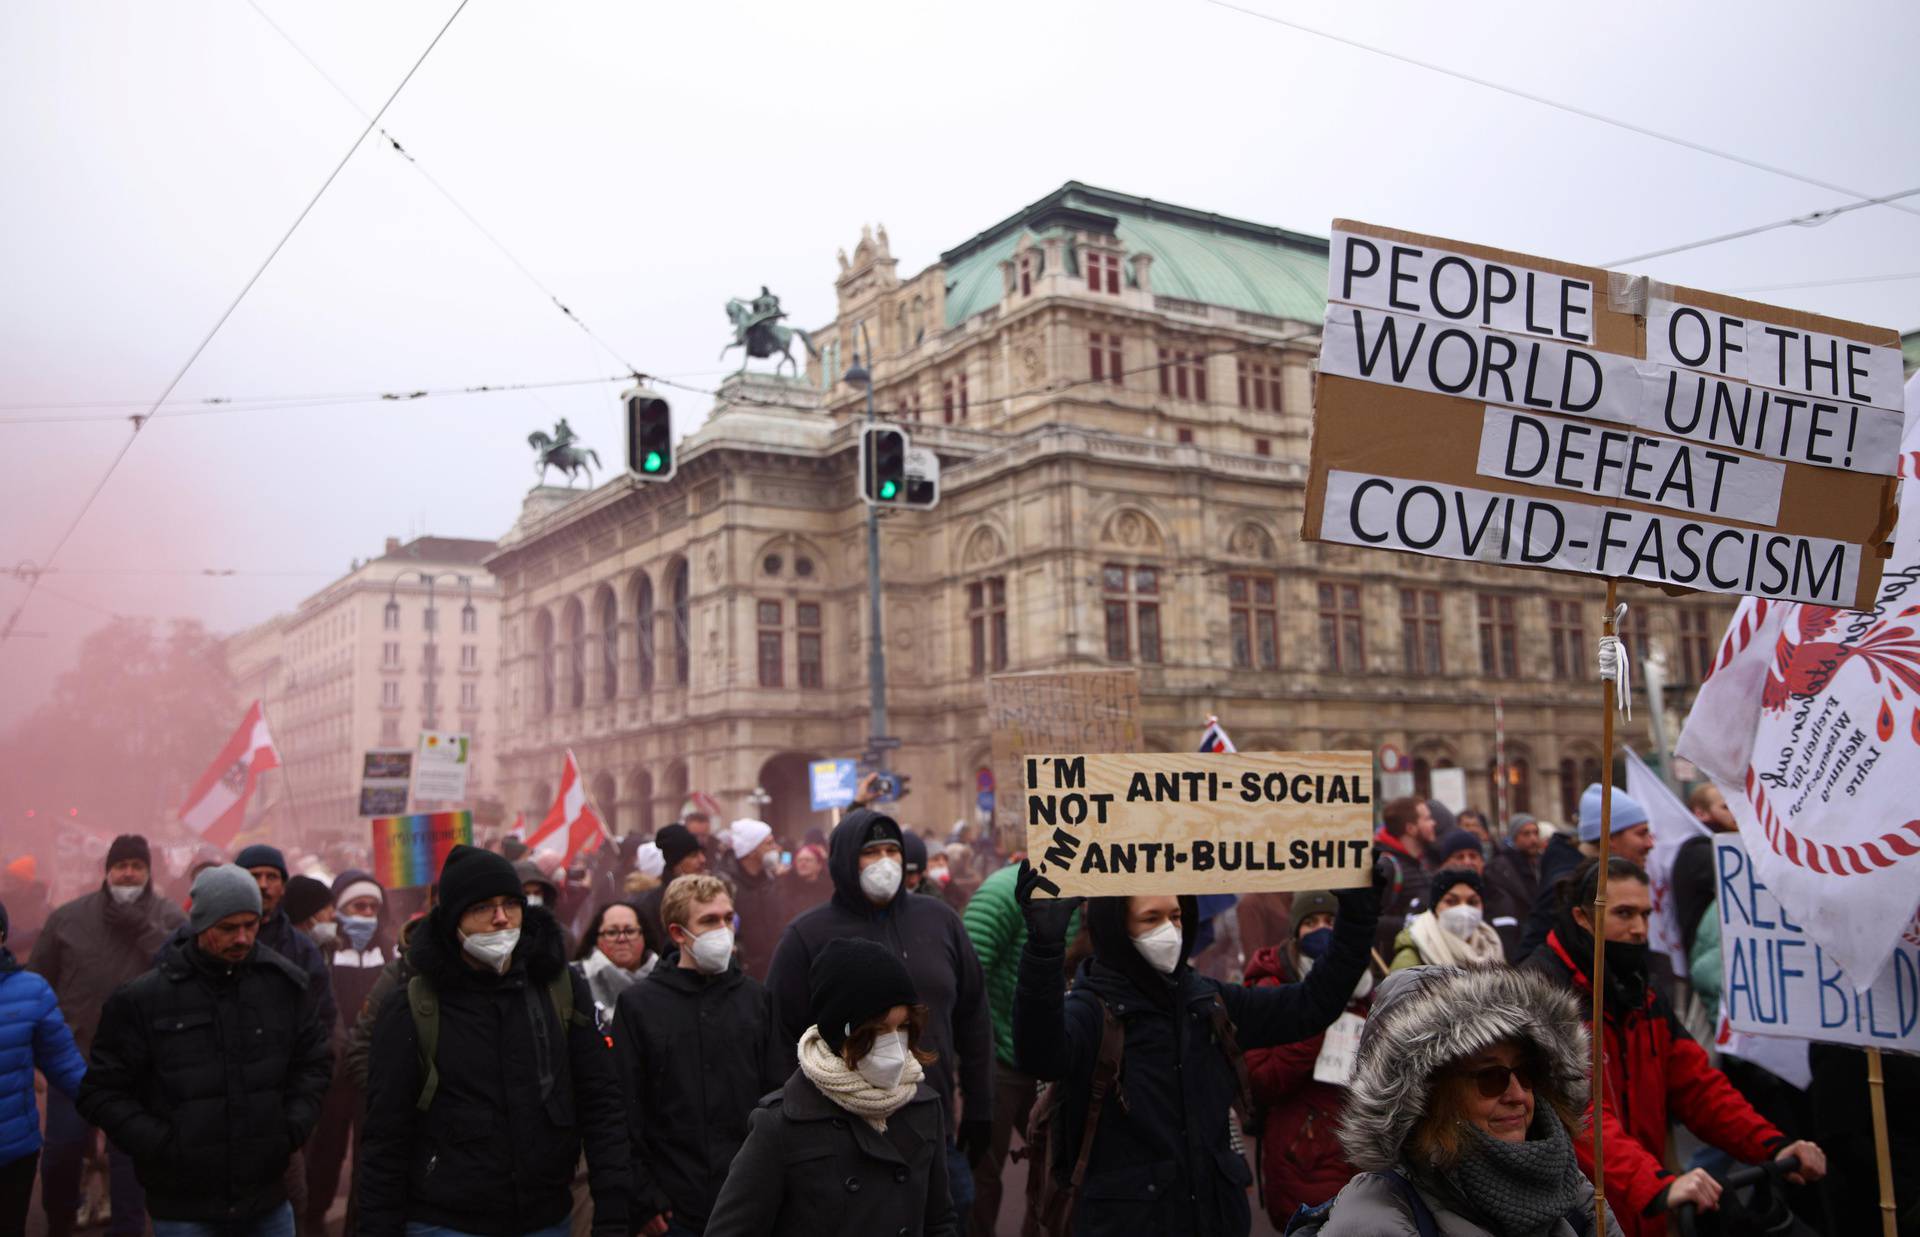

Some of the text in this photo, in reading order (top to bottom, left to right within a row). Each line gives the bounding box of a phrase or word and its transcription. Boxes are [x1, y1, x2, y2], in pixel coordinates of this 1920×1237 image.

[1342, 236, 1872, 404] PEOPLE OF THE
[1353, 310, 1859, 468] WORLD UNITE!
[1504, 414, 1739, 512] DEFEAT
[1350, 478, 1846, 602] COVID-FASCISM
[1027, 756, 1086, 789] I'M
[1028, 793, 1114, 826] NOT
[1127, 772, 1370, 804] ANTI-SOCIAL
[1080, 840, 1369, 874] ANTI-BULLSHIT
[1730, 936, 1920, 1040] AUF BILD
